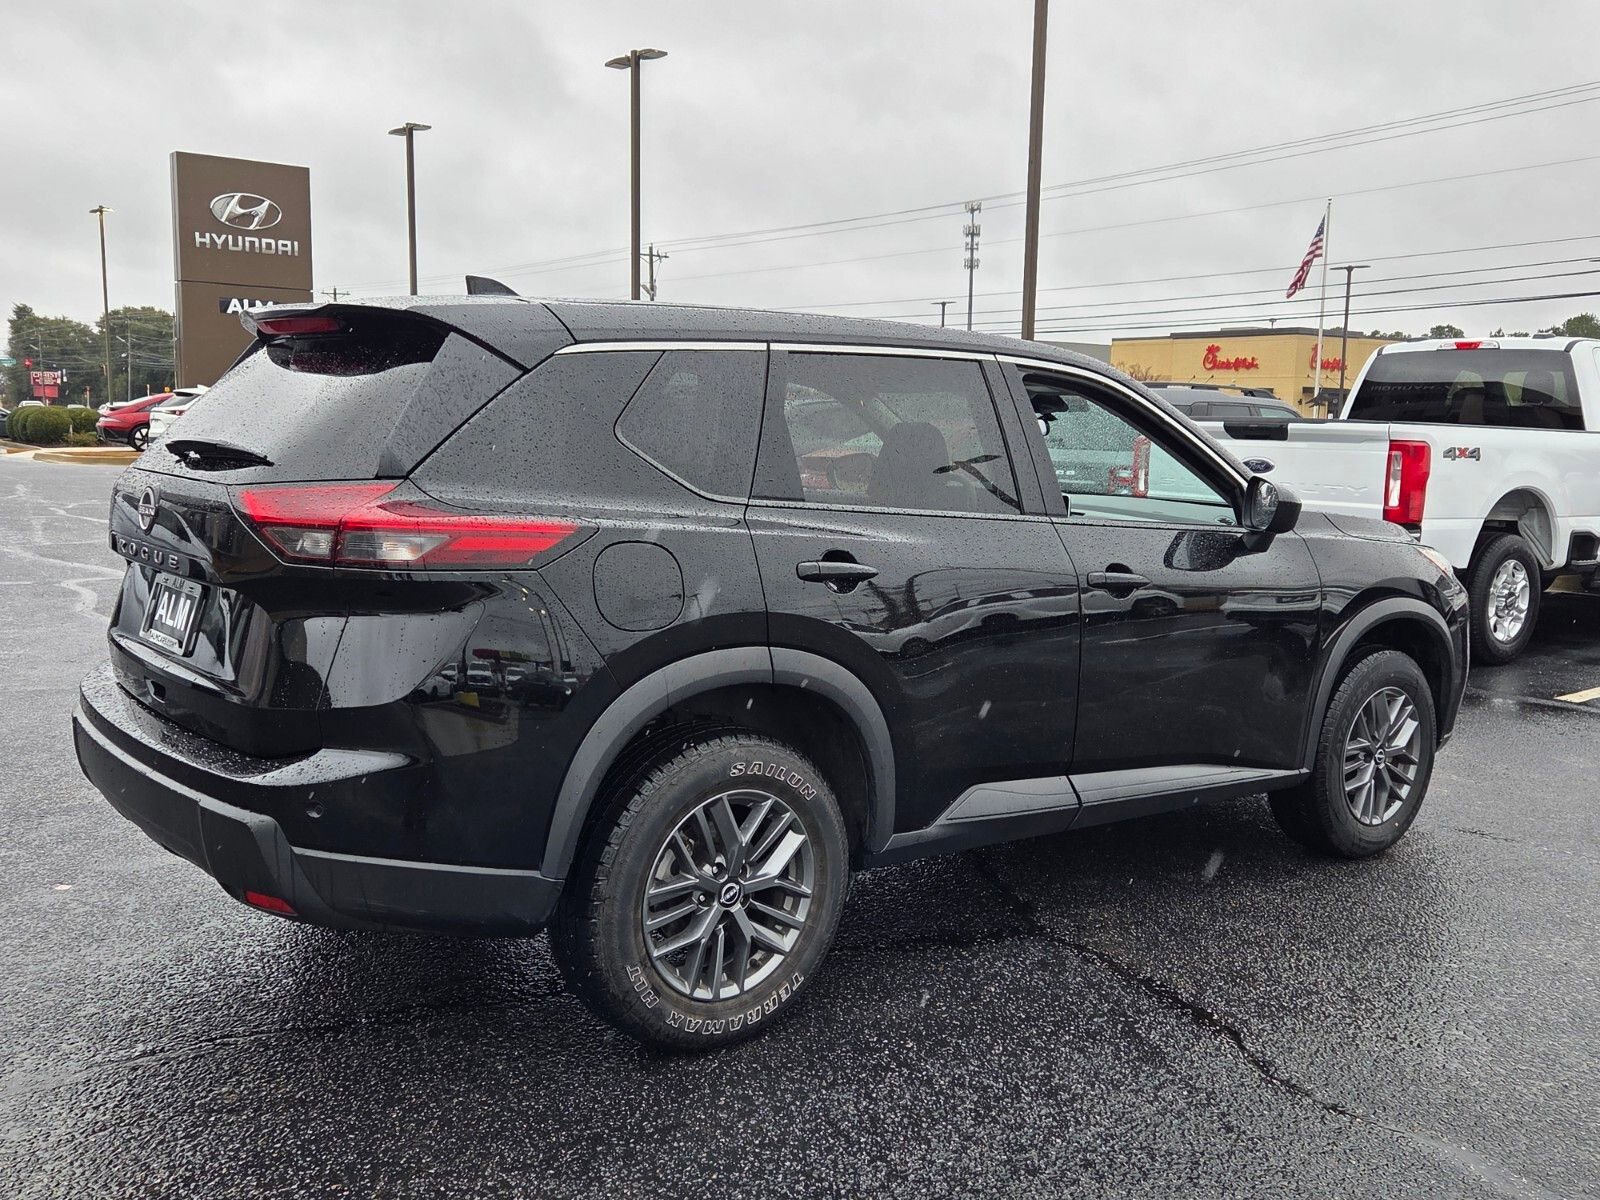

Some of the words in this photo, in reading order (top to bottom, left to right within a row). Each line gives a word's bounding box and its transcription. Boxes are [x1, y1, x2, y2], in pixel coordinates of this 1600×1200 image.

[194, 231, 299, 256] HYUNDAI
[117, 538, 179, 569] ROGUE
[154, 591, 192, 632] ALM
[729, 761, 817, 801] SAILUN
[625, 964, 660, 1009] HLT
[666, 972, 804, 1035] TERRAMAX
